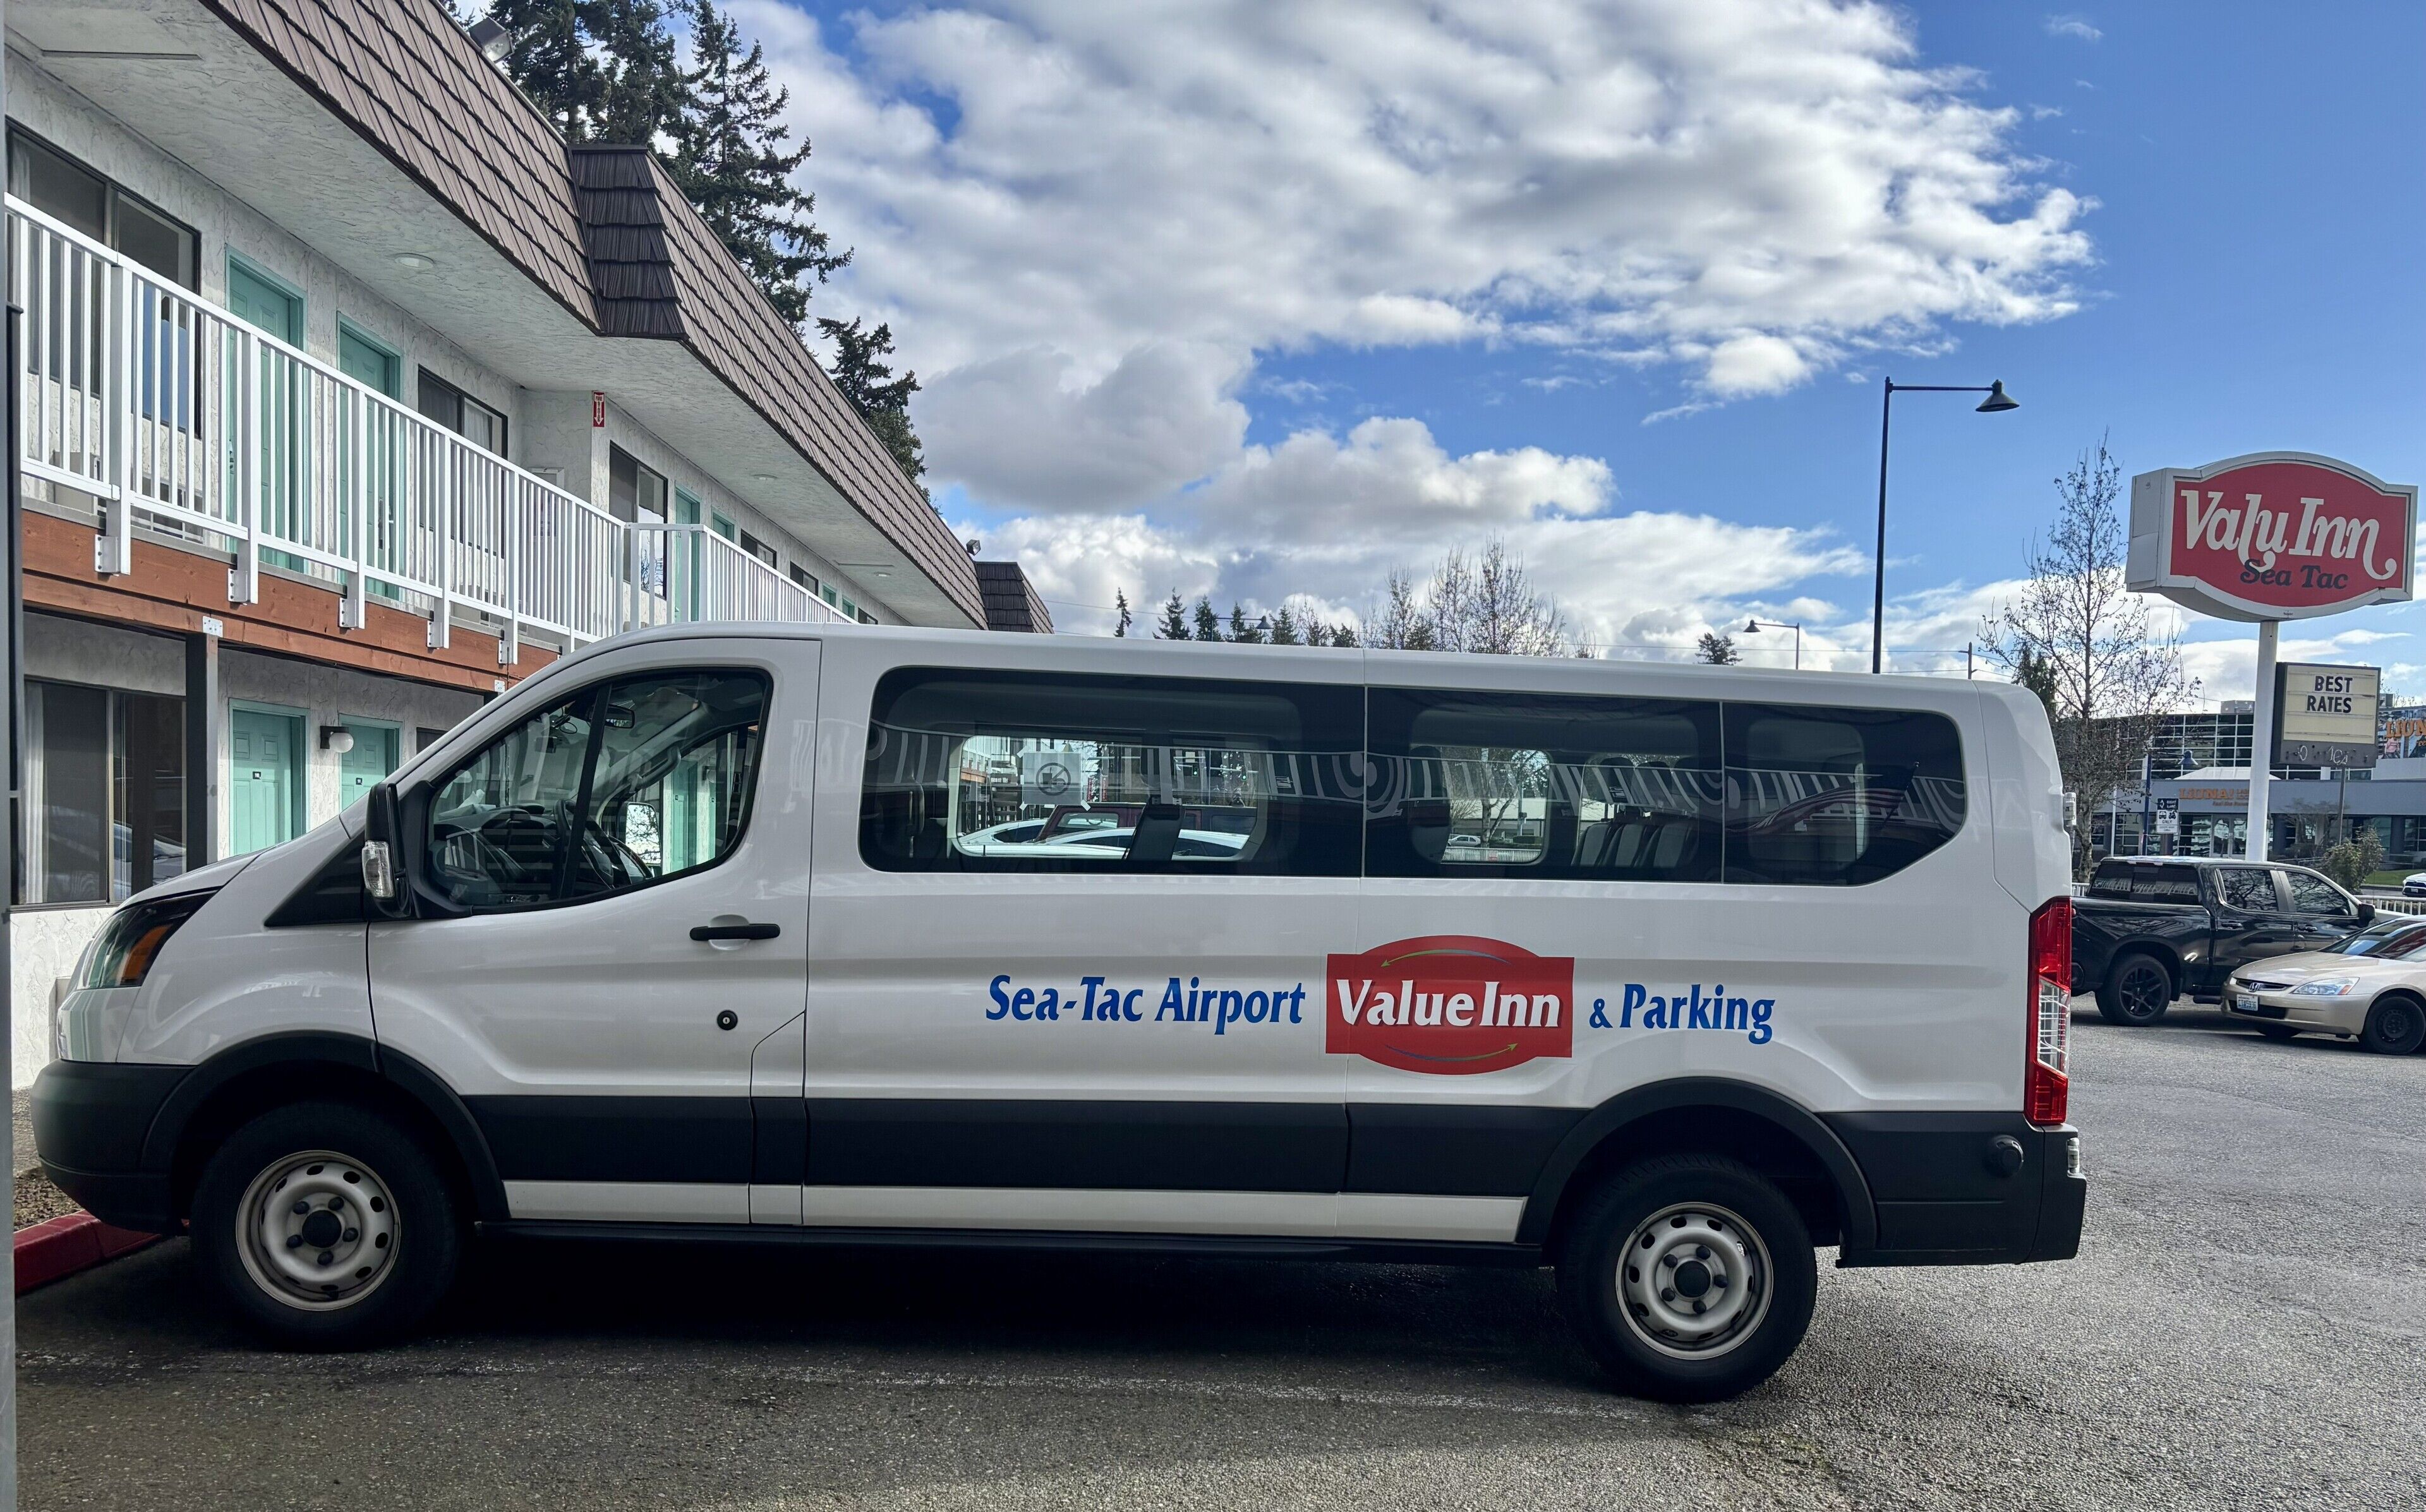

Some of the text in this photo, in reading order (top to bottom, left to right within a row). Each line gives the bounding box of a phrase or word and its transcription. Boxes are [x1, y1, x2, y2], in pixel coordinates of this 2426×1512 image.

[2181, 489, 2398, 580] Valu Inn
[2240, 558, 2348, 590] Sea Tac
[2314, 675, 2353, 693] BEST
[2307, 695, 2352, 714] RATES
[985, 974, 1144, 1022] Sea-Tac
[1154, 976, 1306, 1035] Airport
[1589, 998, 1614, 1029] &
[1619, 983, 1776, 1045] Parking
